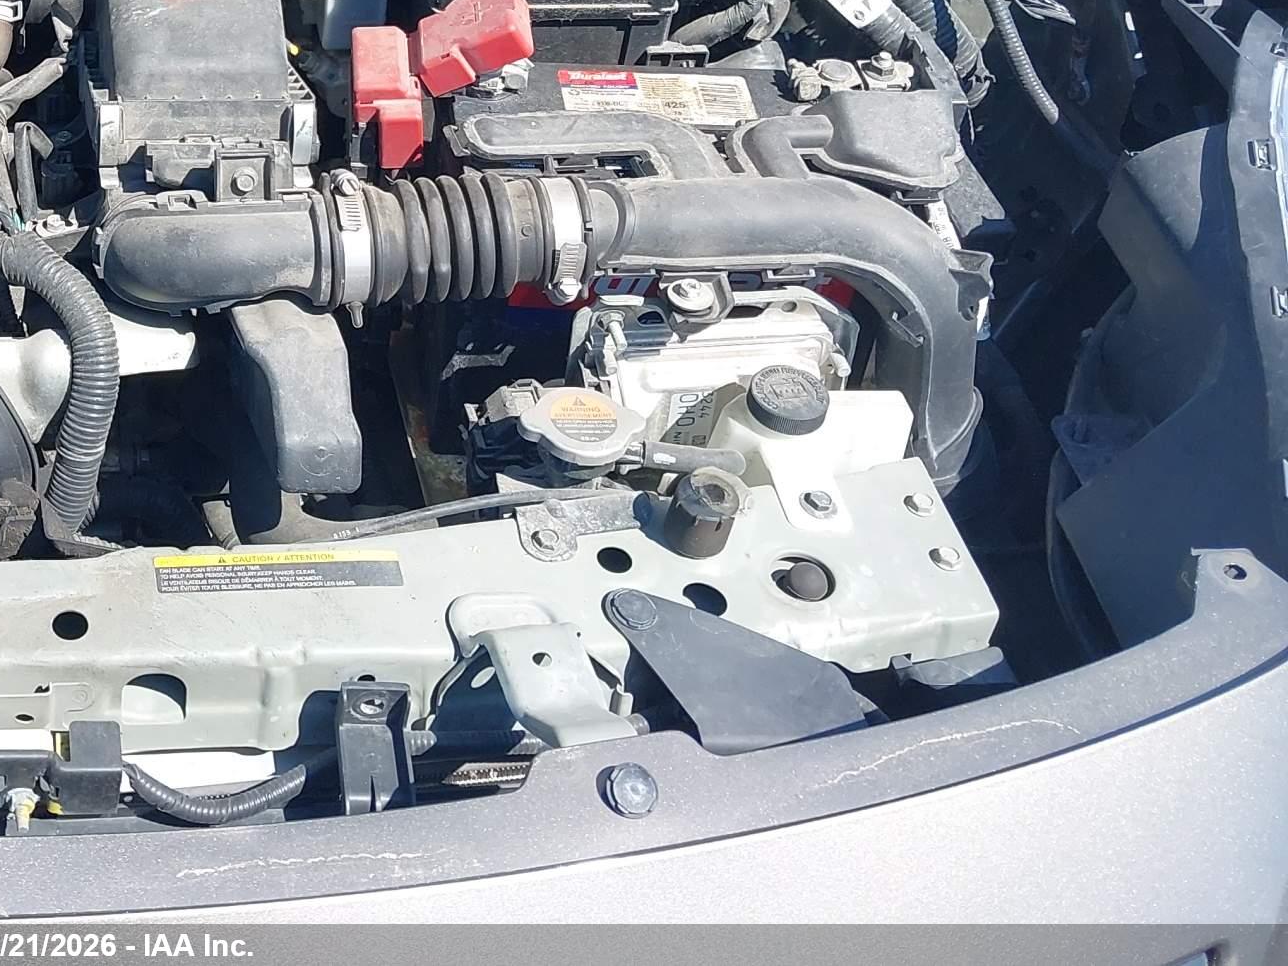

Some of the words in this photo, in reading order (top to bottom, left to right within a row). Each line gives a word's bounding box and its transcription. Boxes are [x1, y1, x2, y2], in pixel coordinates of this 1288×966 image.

[568, 71, 627, 82] Duralast
[664, 101, 686, 109] 425
[232, 555, 273, 563] CAUTION
[284, 553, 334, 561] ATTENTION
